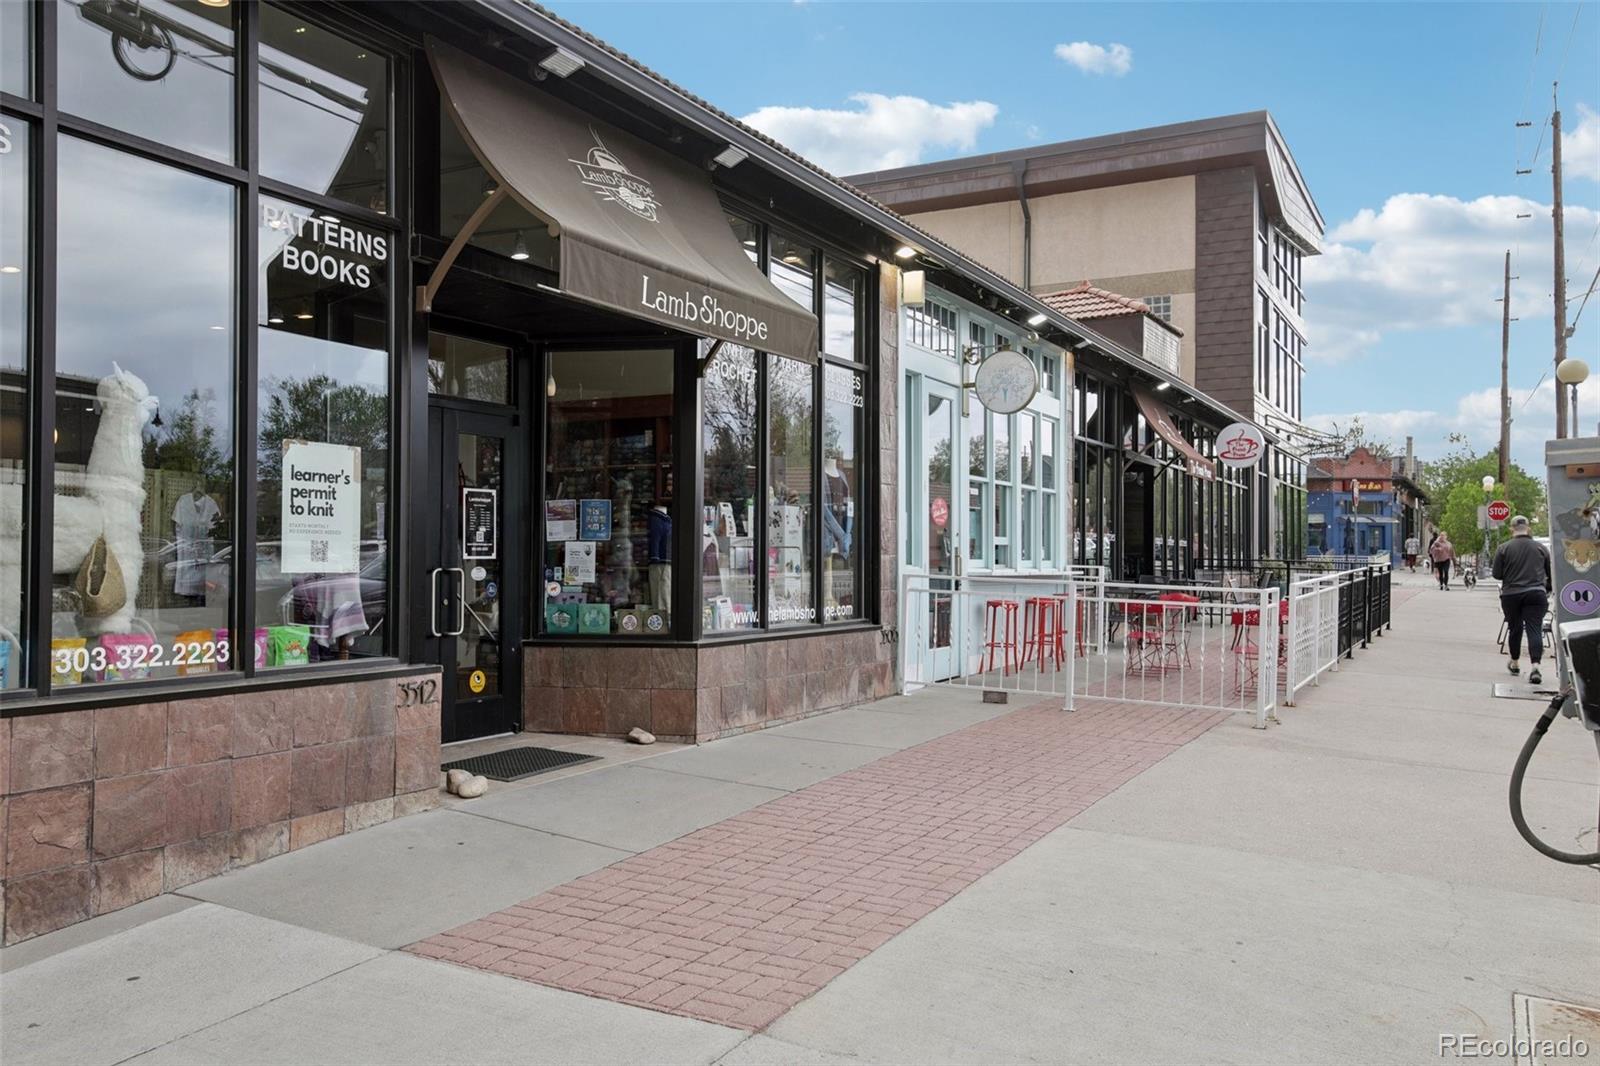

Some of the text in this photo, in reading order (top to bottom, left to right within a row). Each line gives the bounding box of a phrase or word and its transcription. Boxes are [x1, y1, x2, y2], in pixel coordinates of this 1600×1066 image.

[577, 164, 616, 186] Lamb
[263, 203, 387, 260] PATTERNS
[283, 244, 371, 289] BOOKS
[641, 275, 768, 340] Lamb Shoppe
[290, 464, 351, 485] learner's
[290, 485, 337, 504] permit
[290, 500, 335, 517] to knit
[1489, 507, 1509, 516] STOP
[55, 640, 230, 674] 303.322.2223
[397, 679, 439, 708] 3512
